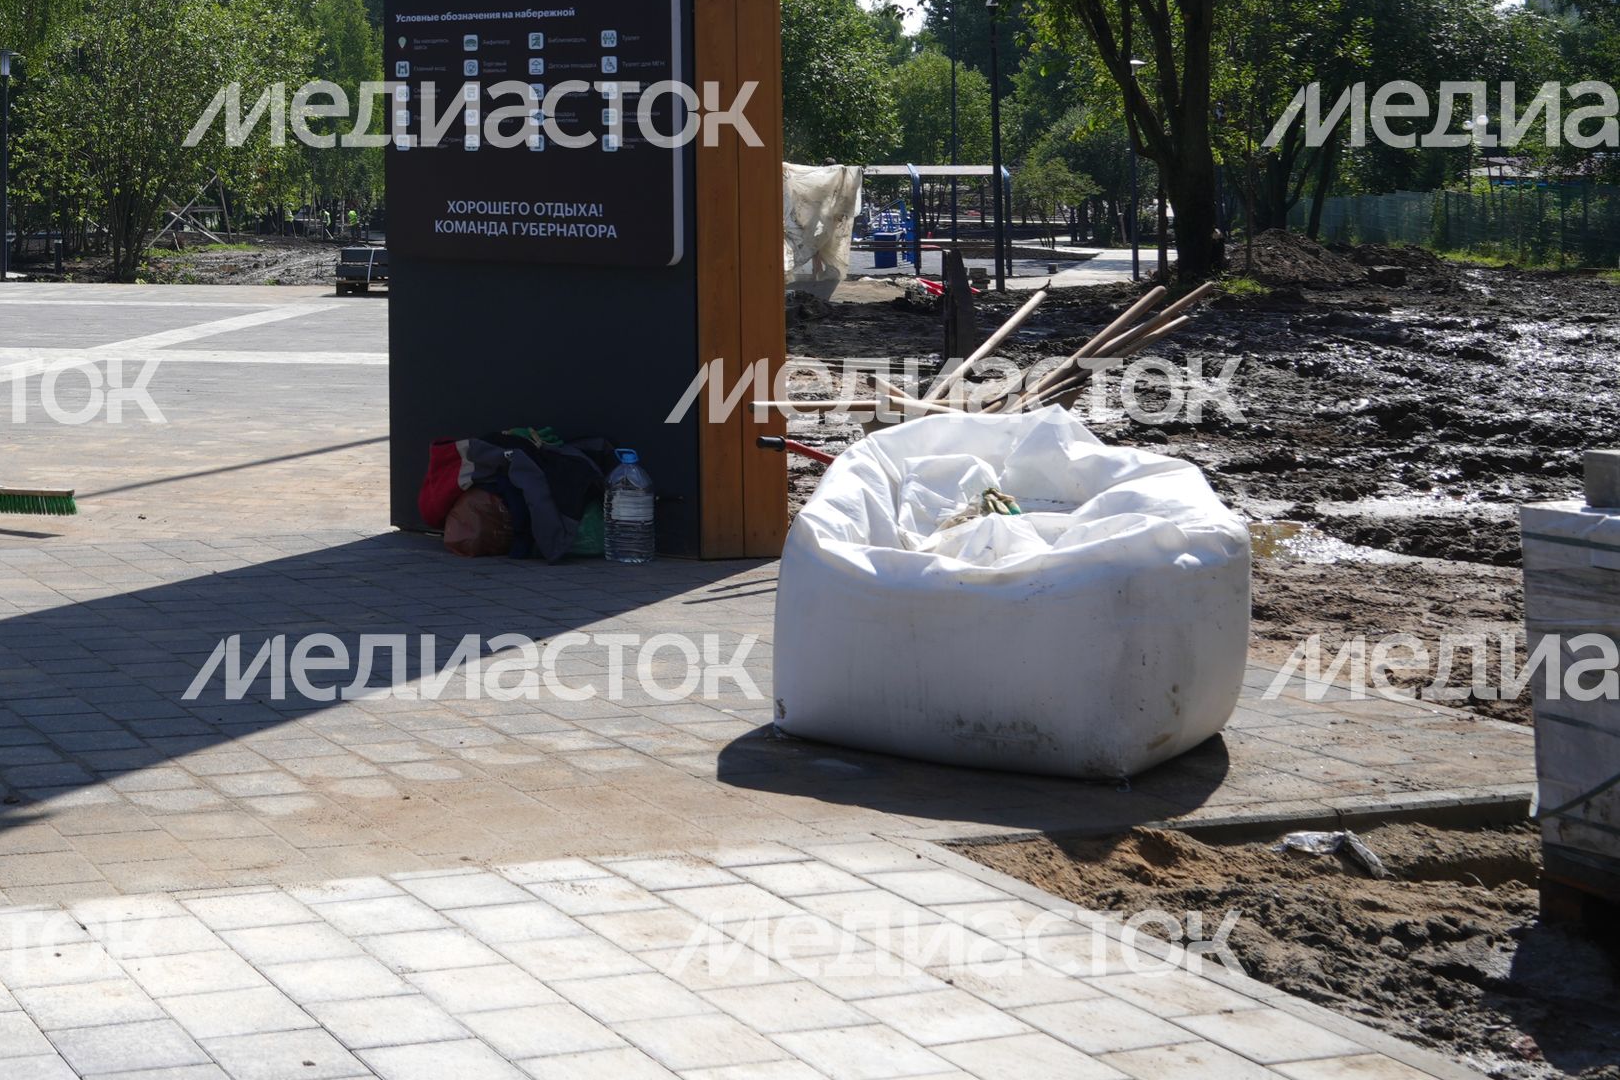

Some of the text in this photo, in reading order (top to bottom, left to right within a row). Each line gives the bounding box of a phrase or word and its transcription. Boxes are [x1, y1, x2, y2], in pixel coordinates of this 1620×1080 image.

[395, 13, 439, 23] Условные
[440, 11, 501, 21] обозначения
[514, 7, 575, 19] набережной
[446, 200, 603, 219] ХОРОШЕГО ОТДЫХА!
[434, 220, 617, 239] КОМАНДА ГУБЕРНАТОРА
